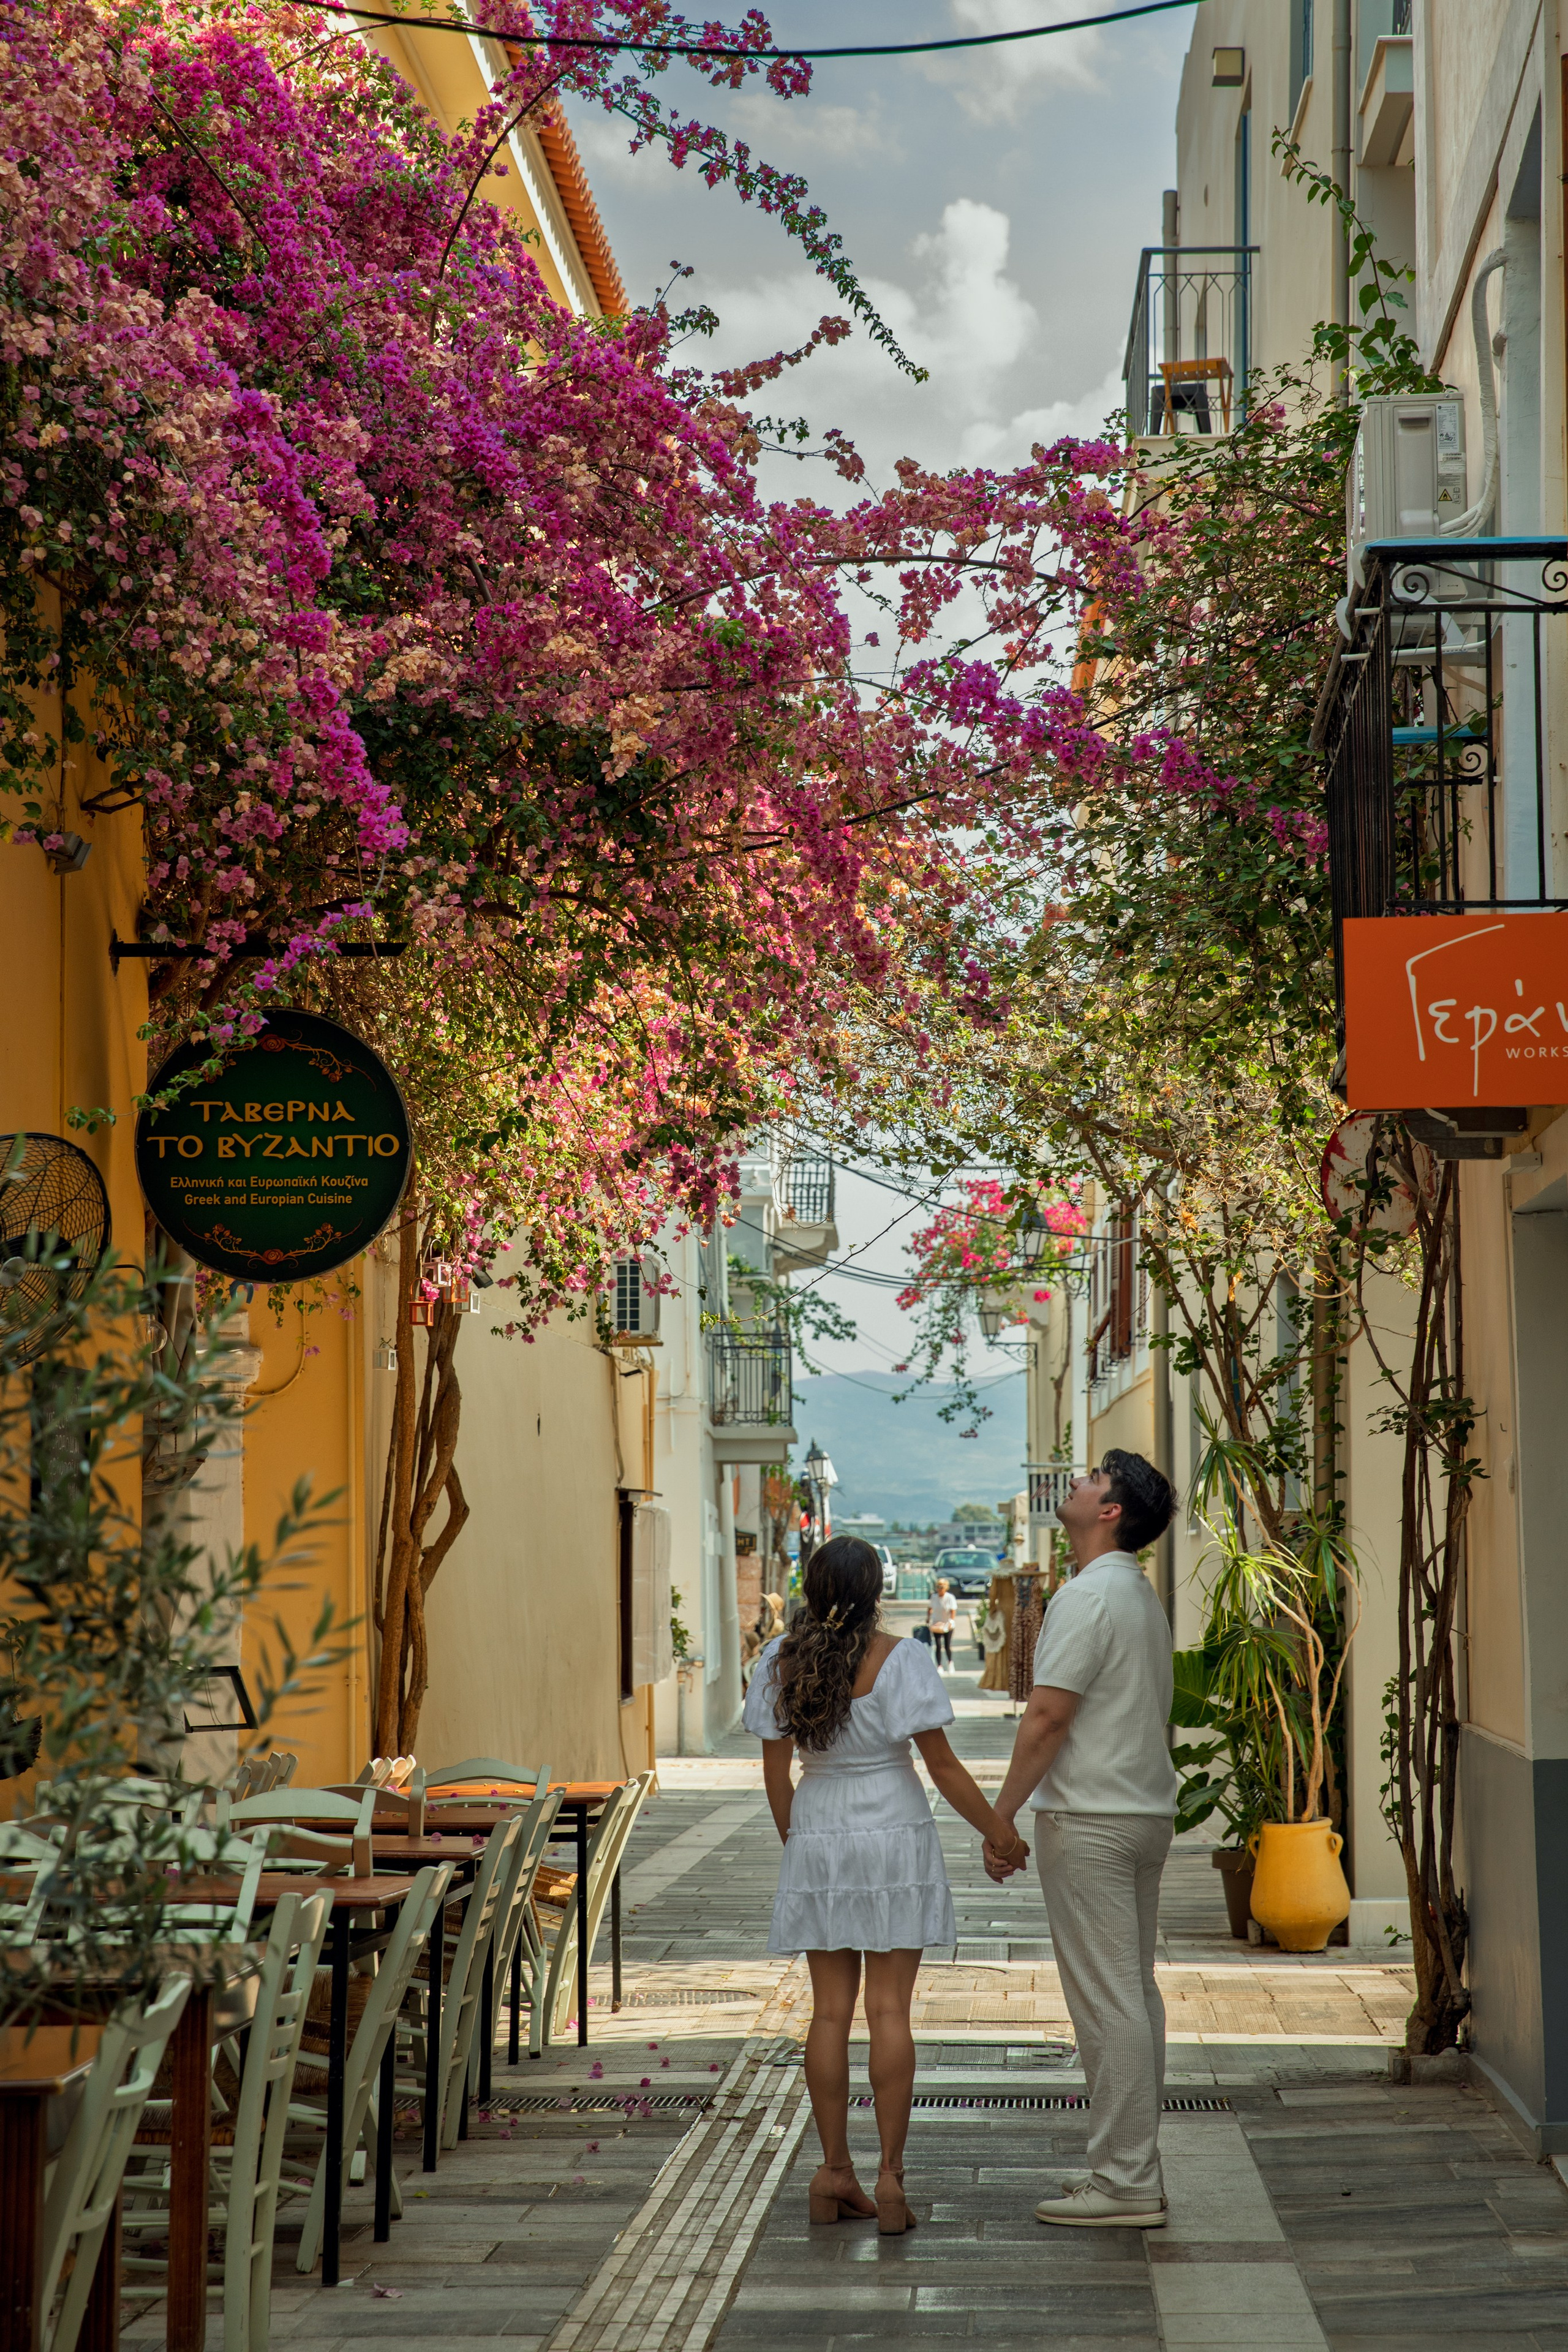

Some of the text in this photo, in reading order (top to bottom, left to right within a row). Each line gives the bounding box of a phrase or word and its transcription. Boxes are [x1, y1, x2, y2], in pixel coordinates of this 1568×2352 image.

[146, 1132, 400, 1159] ΤΟ ΒΥΖΑΝΤΙΟ
[170, 1175, 368, 1189] Ελληνική και Ευρωπαϊκή Κουζίνα
[184, 1193, 353, 1207] Greek and Europian Cuisine
